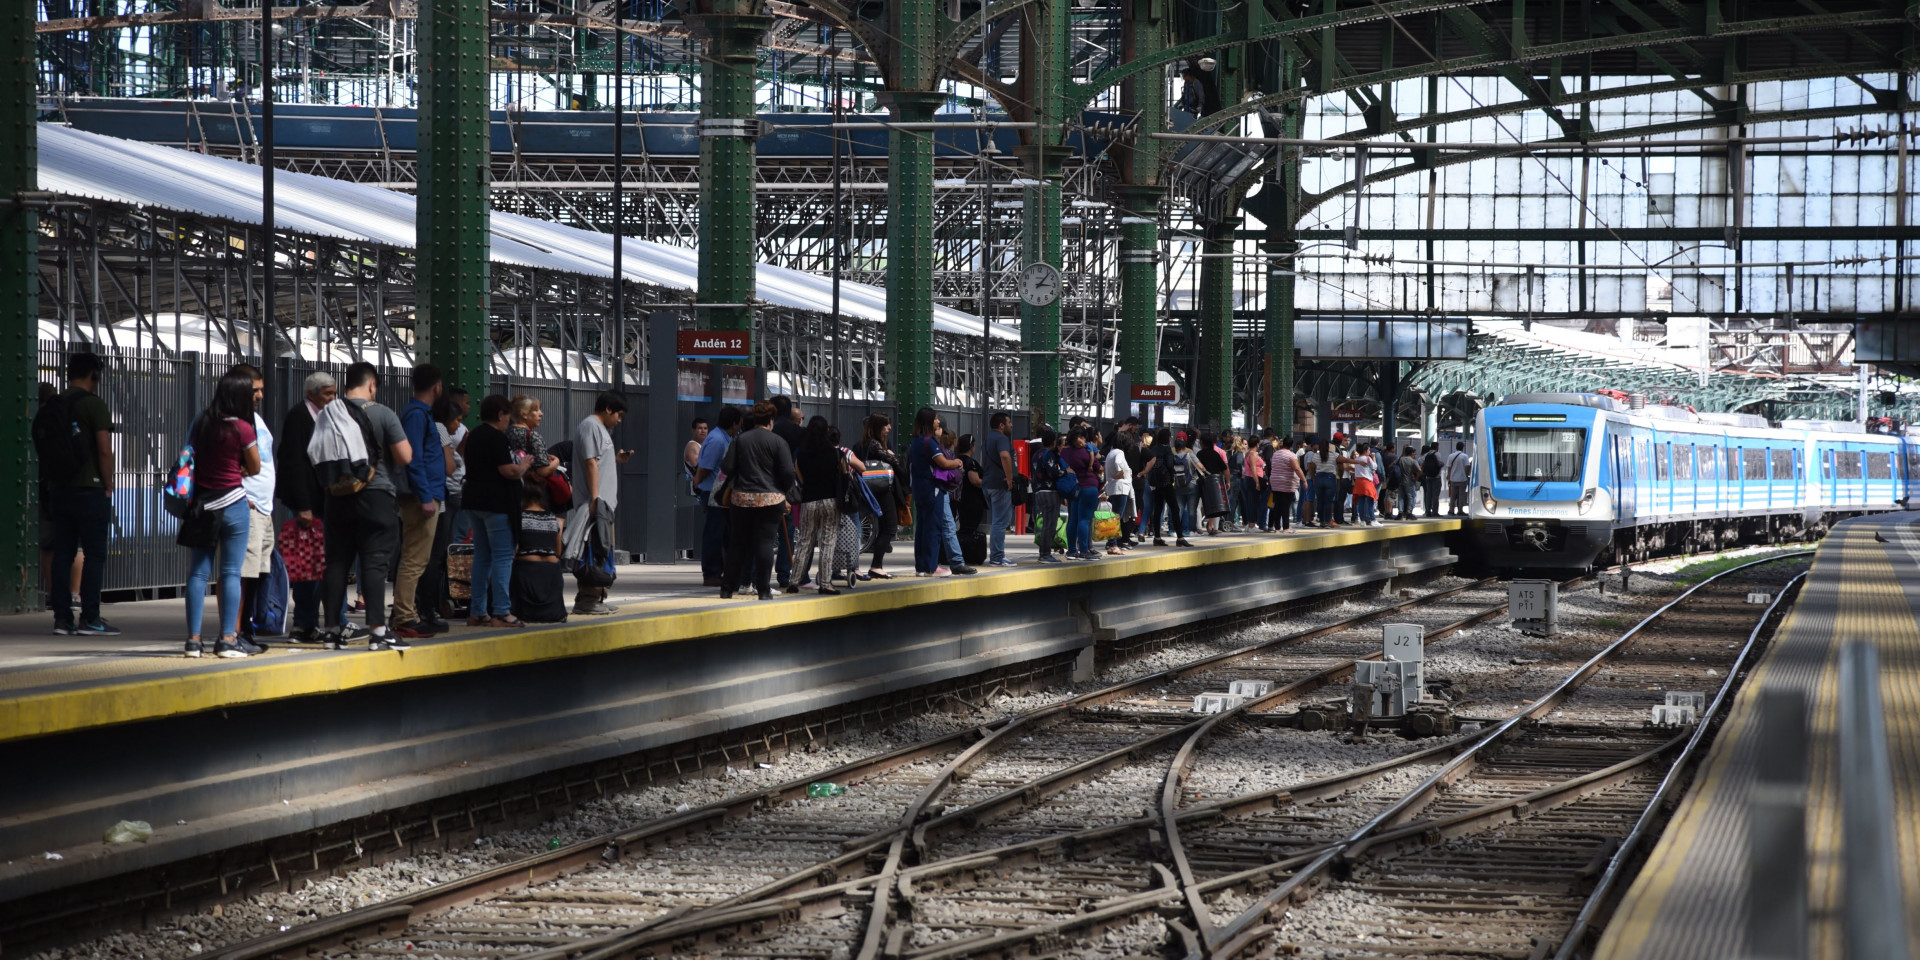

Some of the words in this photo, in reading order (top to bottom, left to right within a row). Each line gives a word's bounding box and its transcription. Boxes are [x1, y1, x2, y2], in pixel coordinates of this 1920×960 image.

[694, 338, 726, 348] Andén
[730, 340, 742, 348] 12
[1508, 507, 1531, 515] Trenes
[1532, 508, 1568, 516] Argentinos
[1518, 590, 1534, 599] ATS
[1394, 636, 1410, 646] J2
